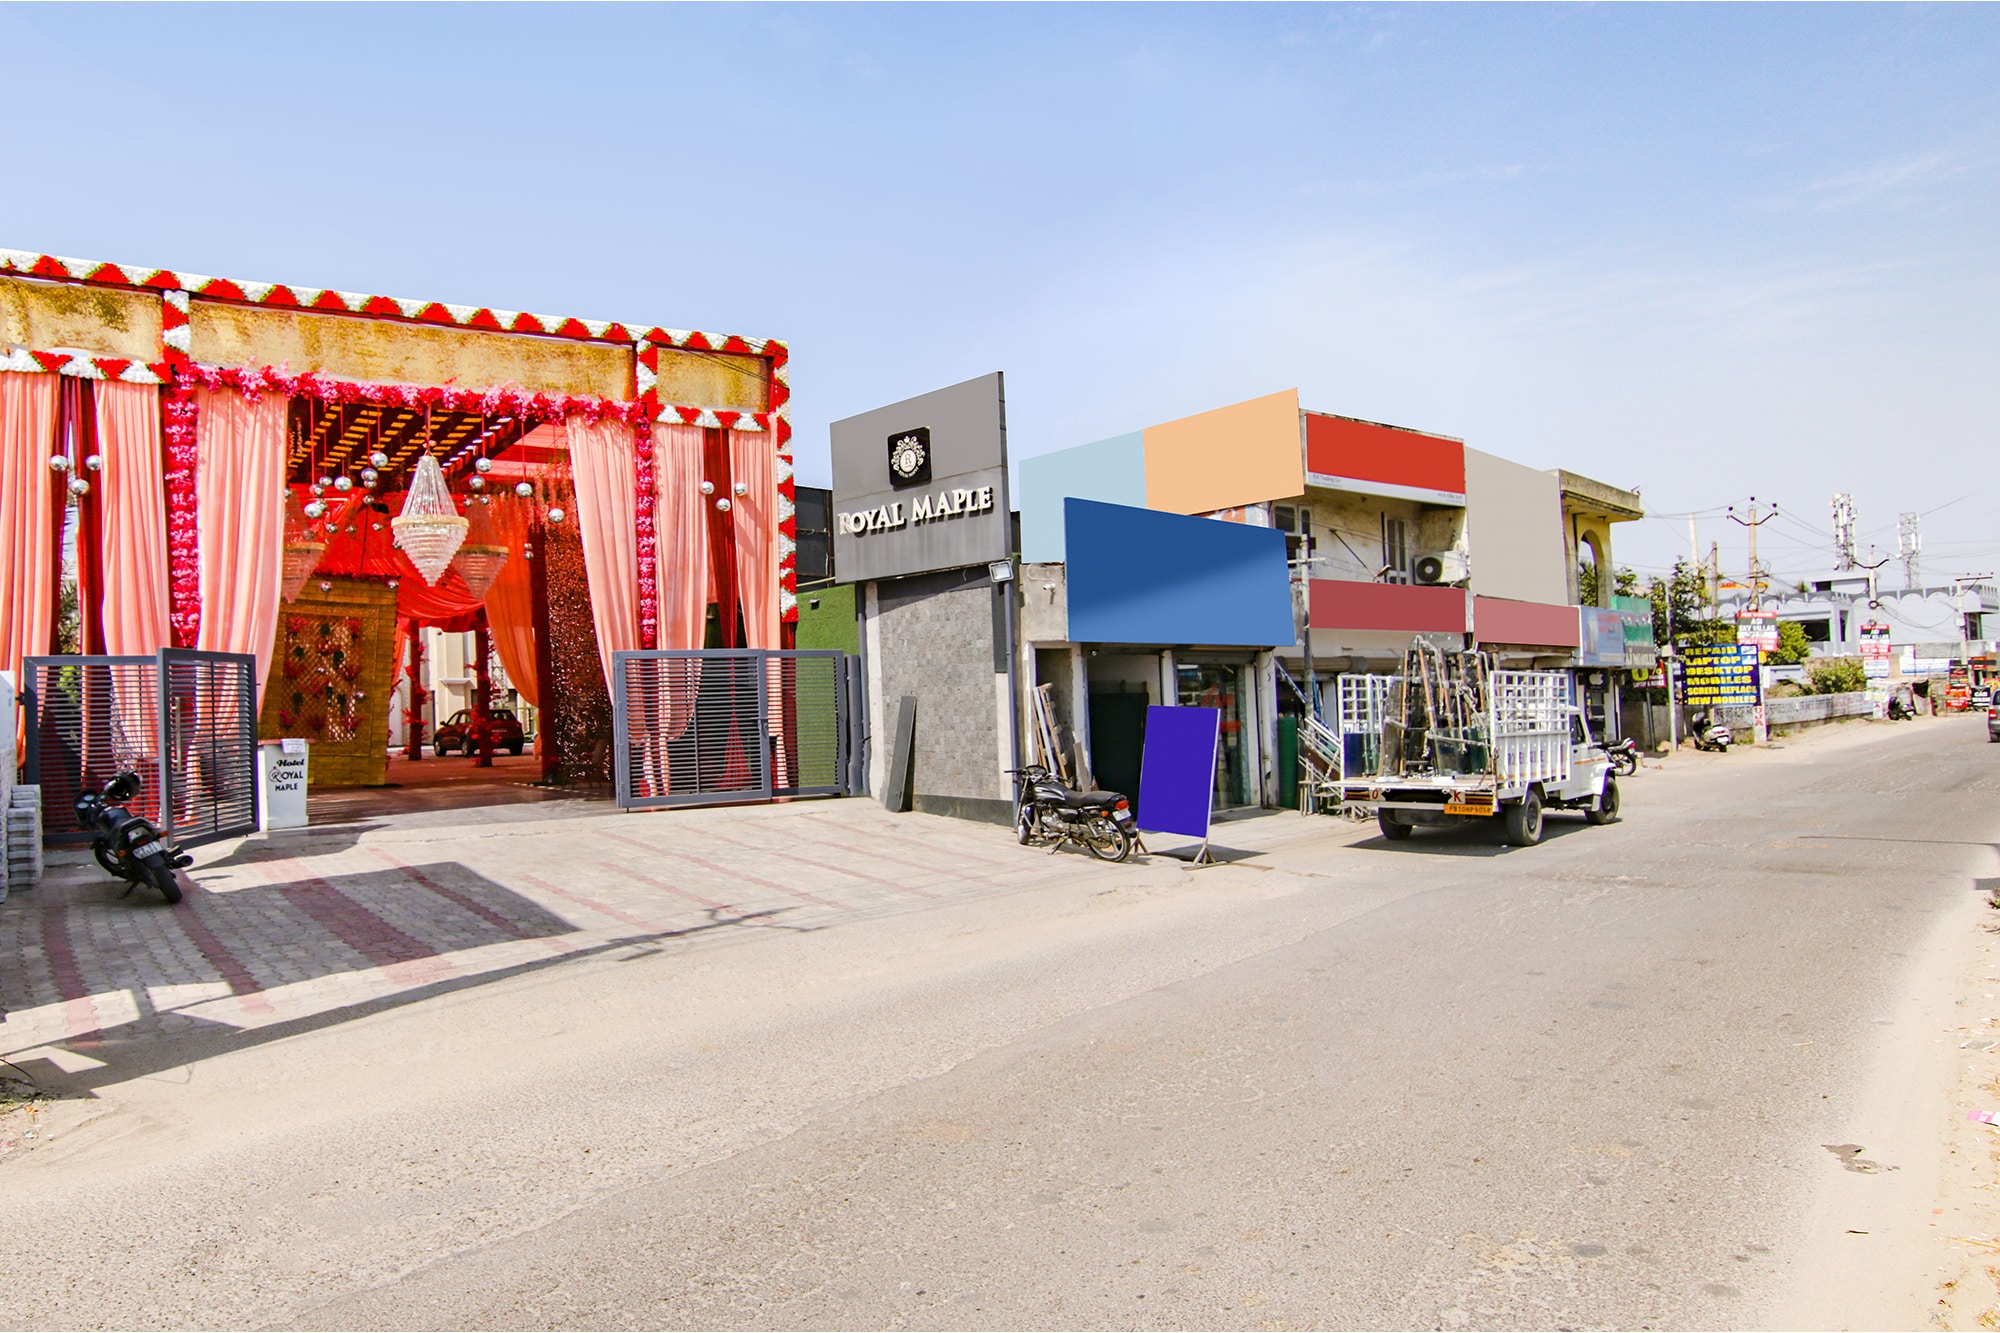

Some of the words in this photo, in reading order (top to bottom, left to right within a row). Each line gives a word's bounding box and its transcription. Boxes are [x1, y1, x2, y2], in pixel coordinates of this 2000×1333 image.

[837, 502, 904, 535] ROYAL
[911, 486, 992, 522] MAPLE
[1685, 646, 1737, 655] REPAIR
[1685, 656, 1741, 666] LAPTOP
[1686, 665, 1754, 675] DESKTOP
[1686, 675, 1752, 685] MOBILES
[1687, 686, 1719, 695] SCREEN
[1688, 696, 1710, 705] NEW
[1712, 695, 1757, 704] MOBILES
[276, 759, 305, 767] Hotel
[270, 769, 304, 783] ROYAL
[275, 783, 298, 791] MAPLE
[1453, 790, 1462, 802] K
